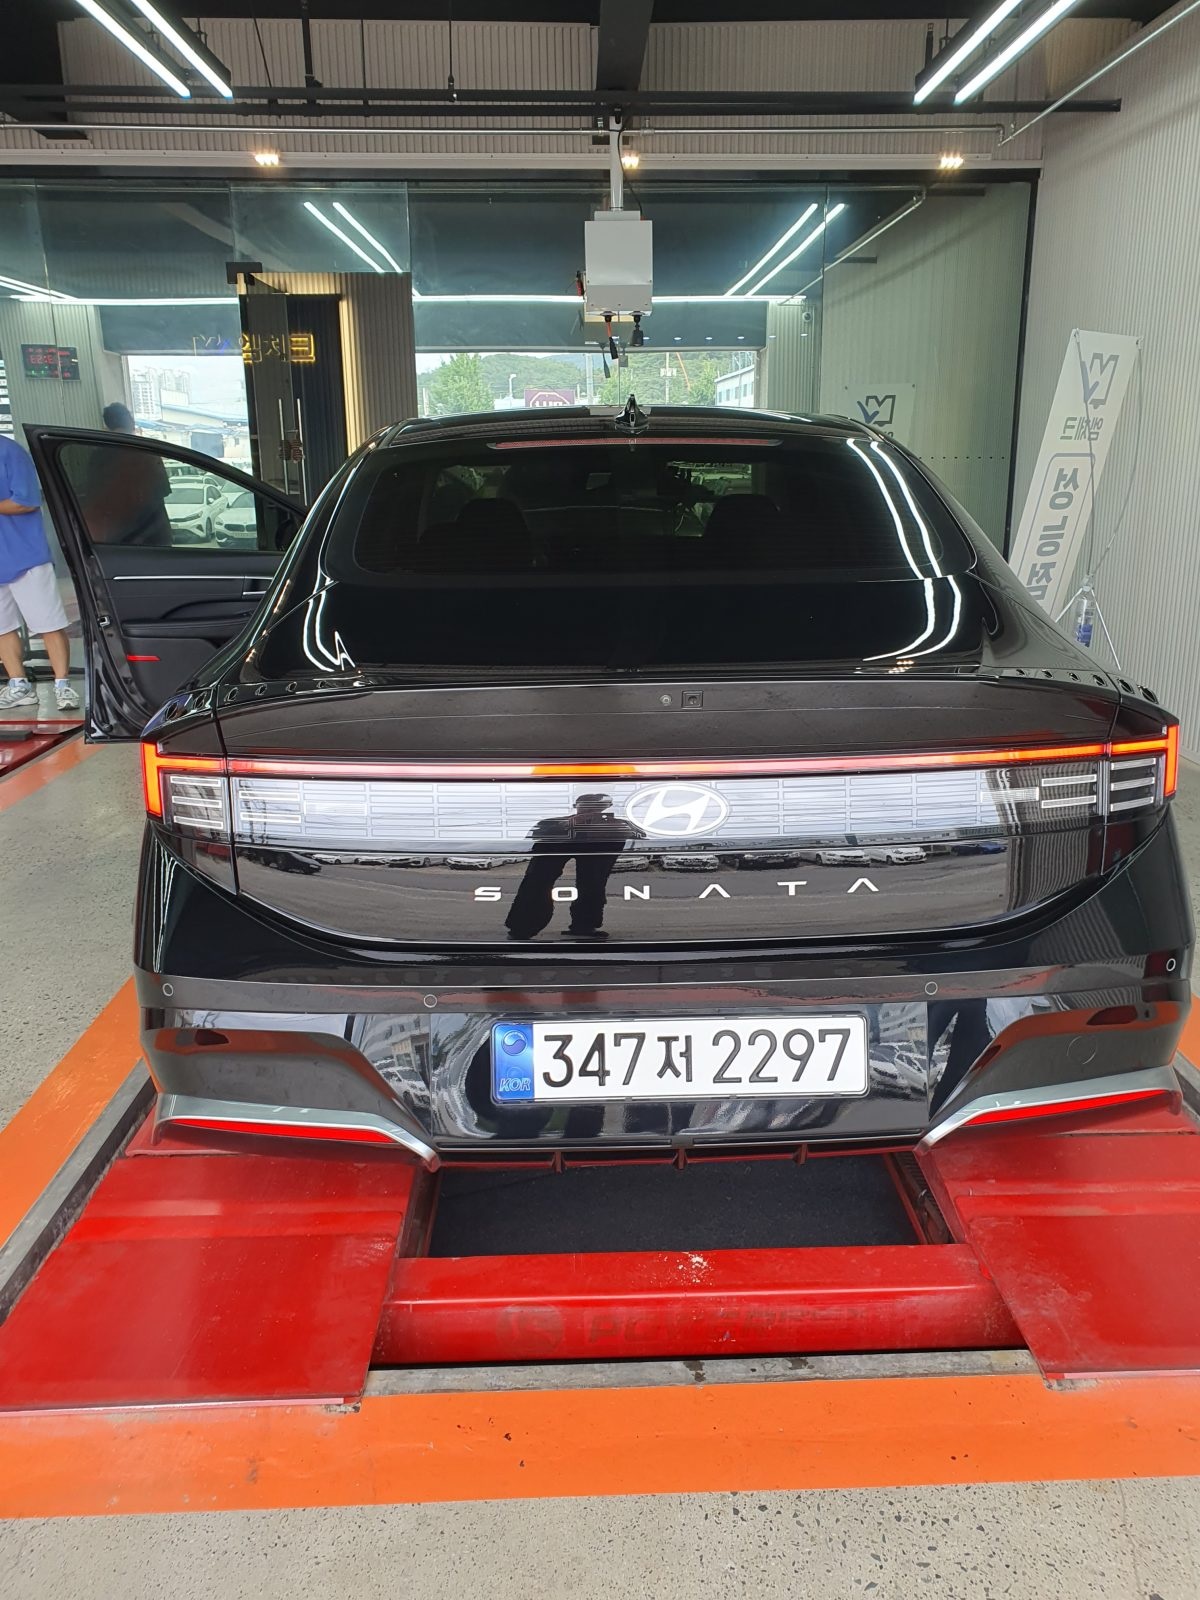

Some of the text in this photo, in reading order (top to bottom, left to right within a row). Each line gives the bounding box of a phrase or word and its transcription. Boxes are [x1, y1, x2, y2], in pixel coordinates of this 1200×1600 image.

[474, 877, 880, 902] SONATA
[542, 1027, 852, 1089] 347저 2297
[499, 1077, 531, 1092] KOR
